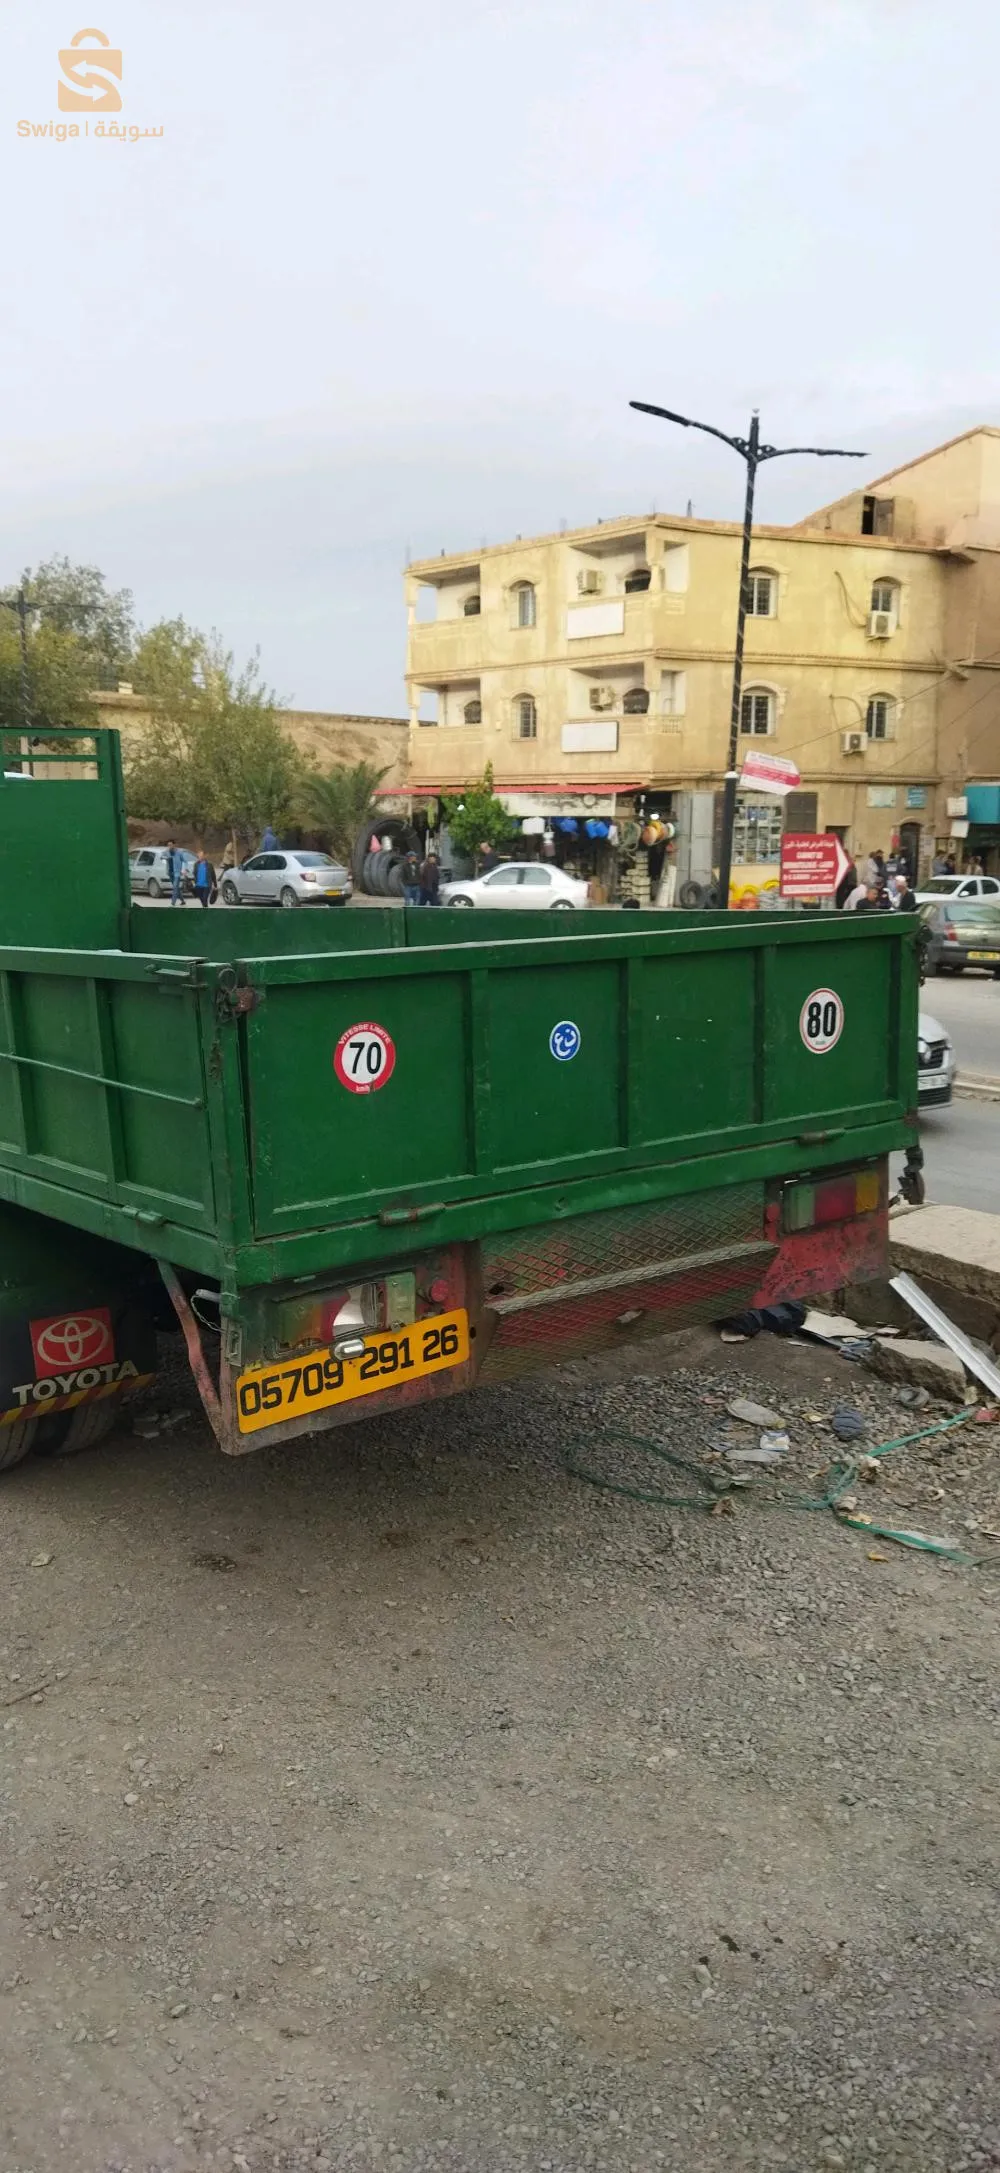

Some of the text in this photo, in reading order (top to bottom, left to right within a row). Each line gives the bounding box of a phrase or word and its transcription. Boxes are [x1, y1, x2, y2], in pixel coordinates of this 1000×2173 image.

[338, 1024, 369, 1045] VITESSE
[807, 1001, 837, 1038] 80
[349, 1041, 382, 1075] 70
[12, 1359, 140, 1406] TOYOTA
[239, 1323, 459, 1417] 05709 291 26
